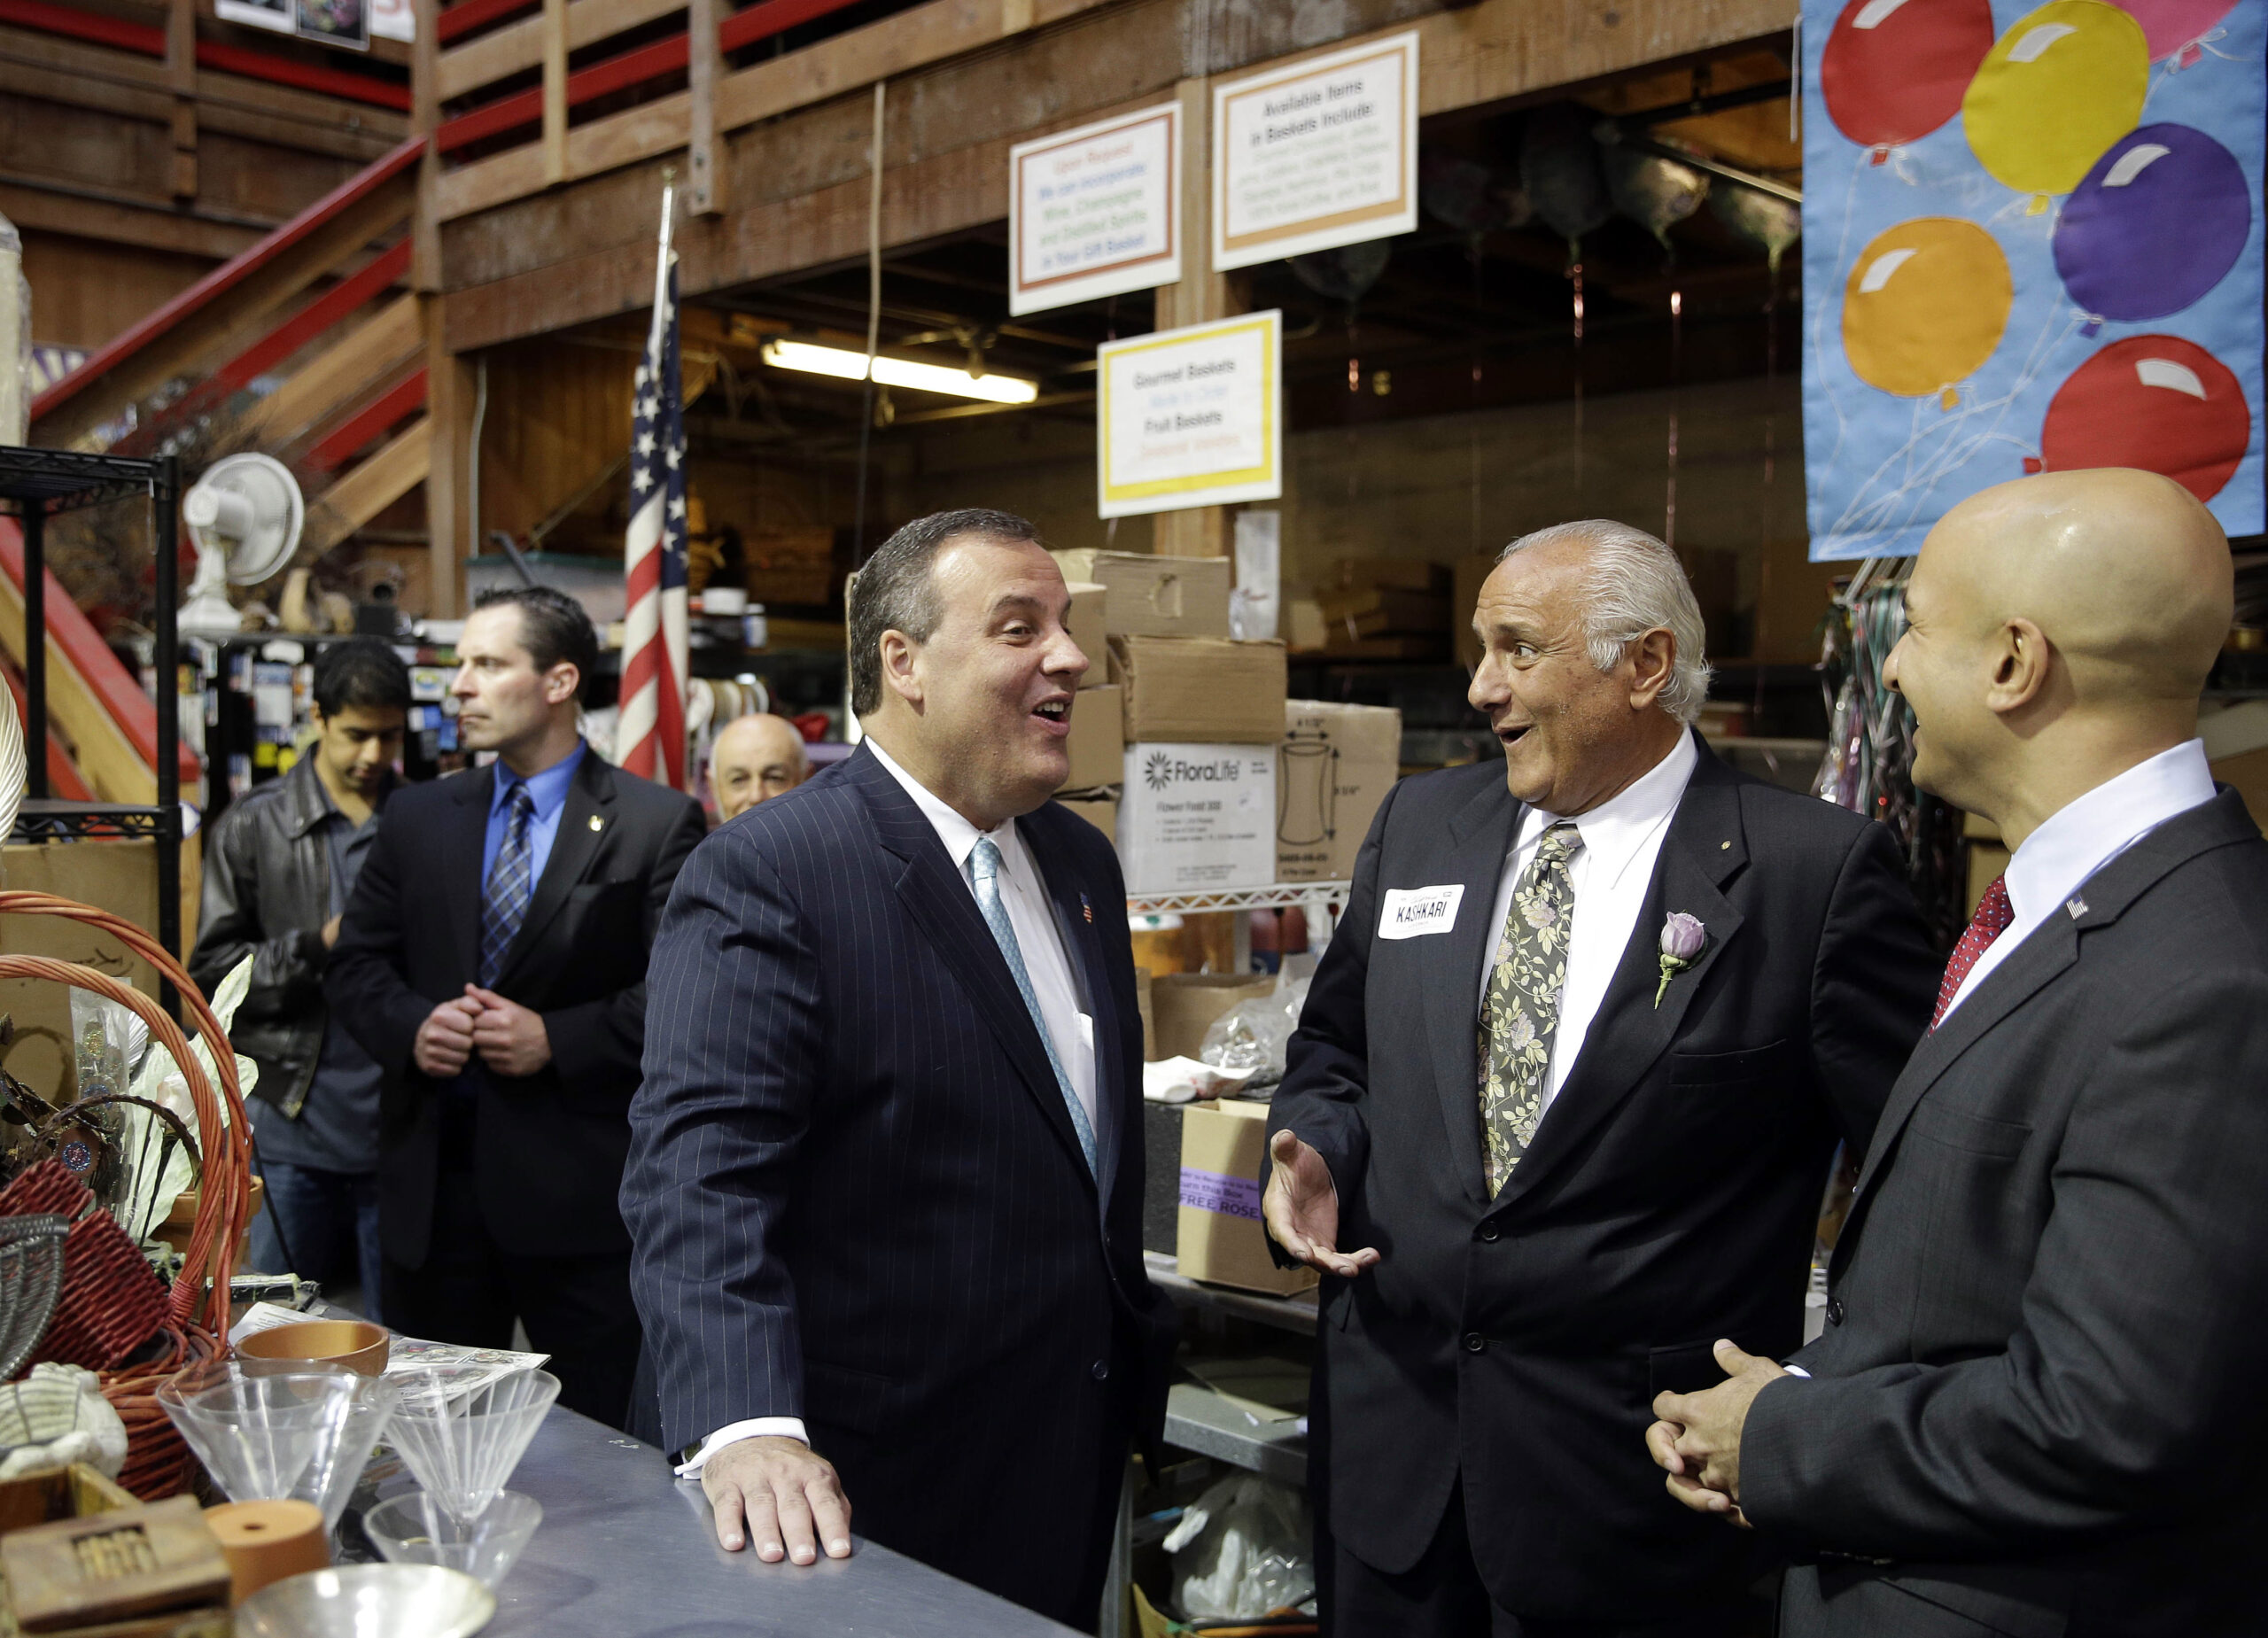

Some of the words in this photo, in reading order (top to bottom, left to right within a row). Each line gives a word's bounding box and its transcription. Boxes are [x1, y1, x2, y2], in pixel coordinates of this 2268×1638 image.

[1263, 89, 1321, 117] Available
[1327, 78, 1363, 99] Items
[1265, 117, 1317, 144] Baskets
[1134, 369, 1183, 390] Gourmet
[1186, 358, 1237, 380] Baskets
[1144, 417, 1171, 435] Fruit
[1175, 411, 1223, 431] Baskets
[1175, 760, 1239, 781] FloraLife
[1396, 901, 1448, 923] KASHKARI
[1180, 1192, 1216, 1209] FREE
[1219, 1200, 1259, 1219] ROSE
